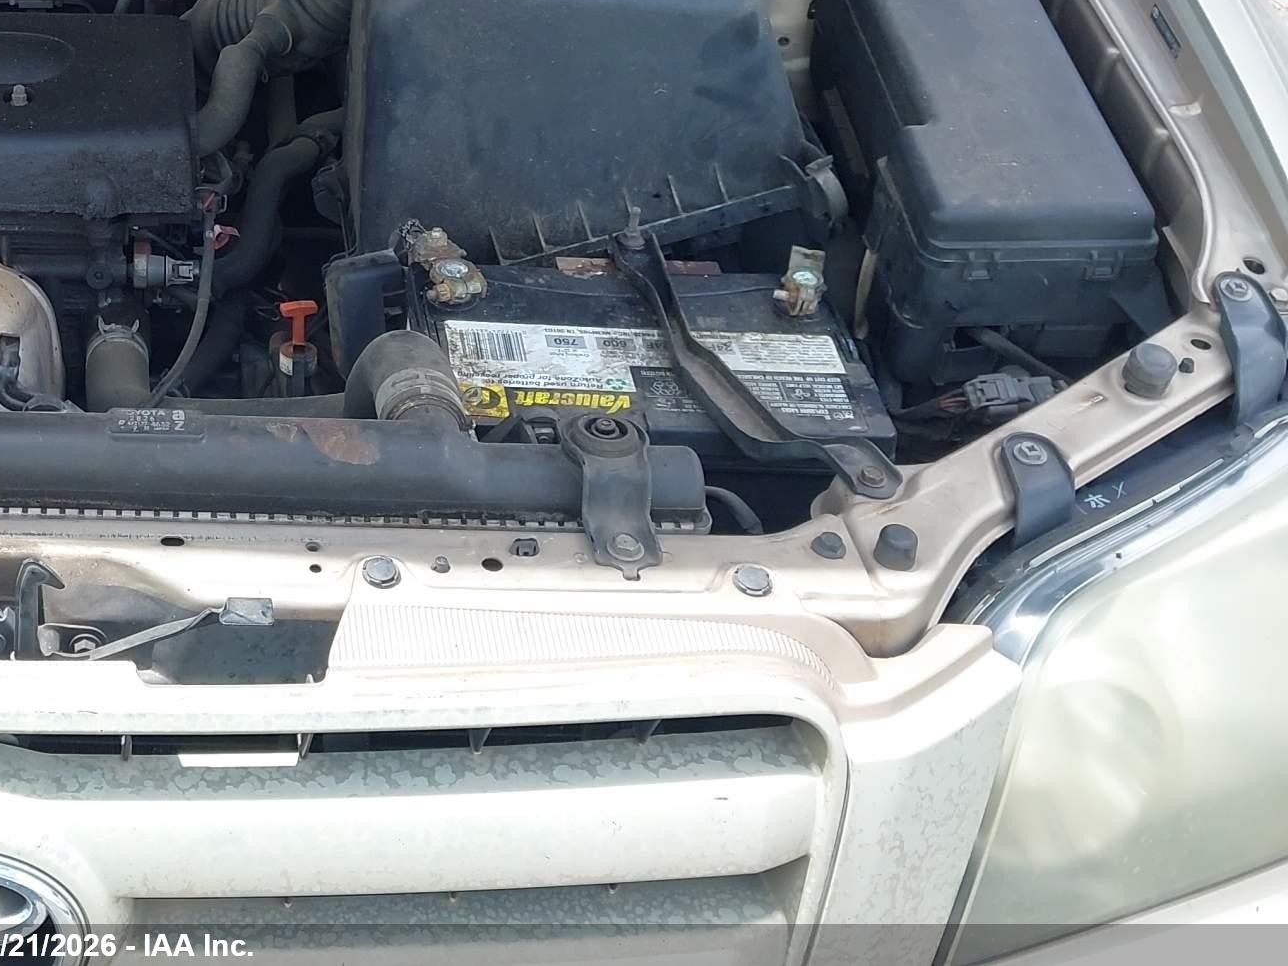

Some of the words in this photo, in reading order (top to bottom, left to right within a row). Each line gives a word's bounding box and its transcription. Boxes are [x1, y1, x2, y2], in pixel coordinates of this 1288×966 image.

[553, 337, 579, 346] 750
[602, 339, 628, 348] 600
[498, 379, 541, 387] batteries
[556, 375, 603, 383] AutoZone
[571, 381, 604, 389] Return
[514, 390, 631, 415] Valucraft
